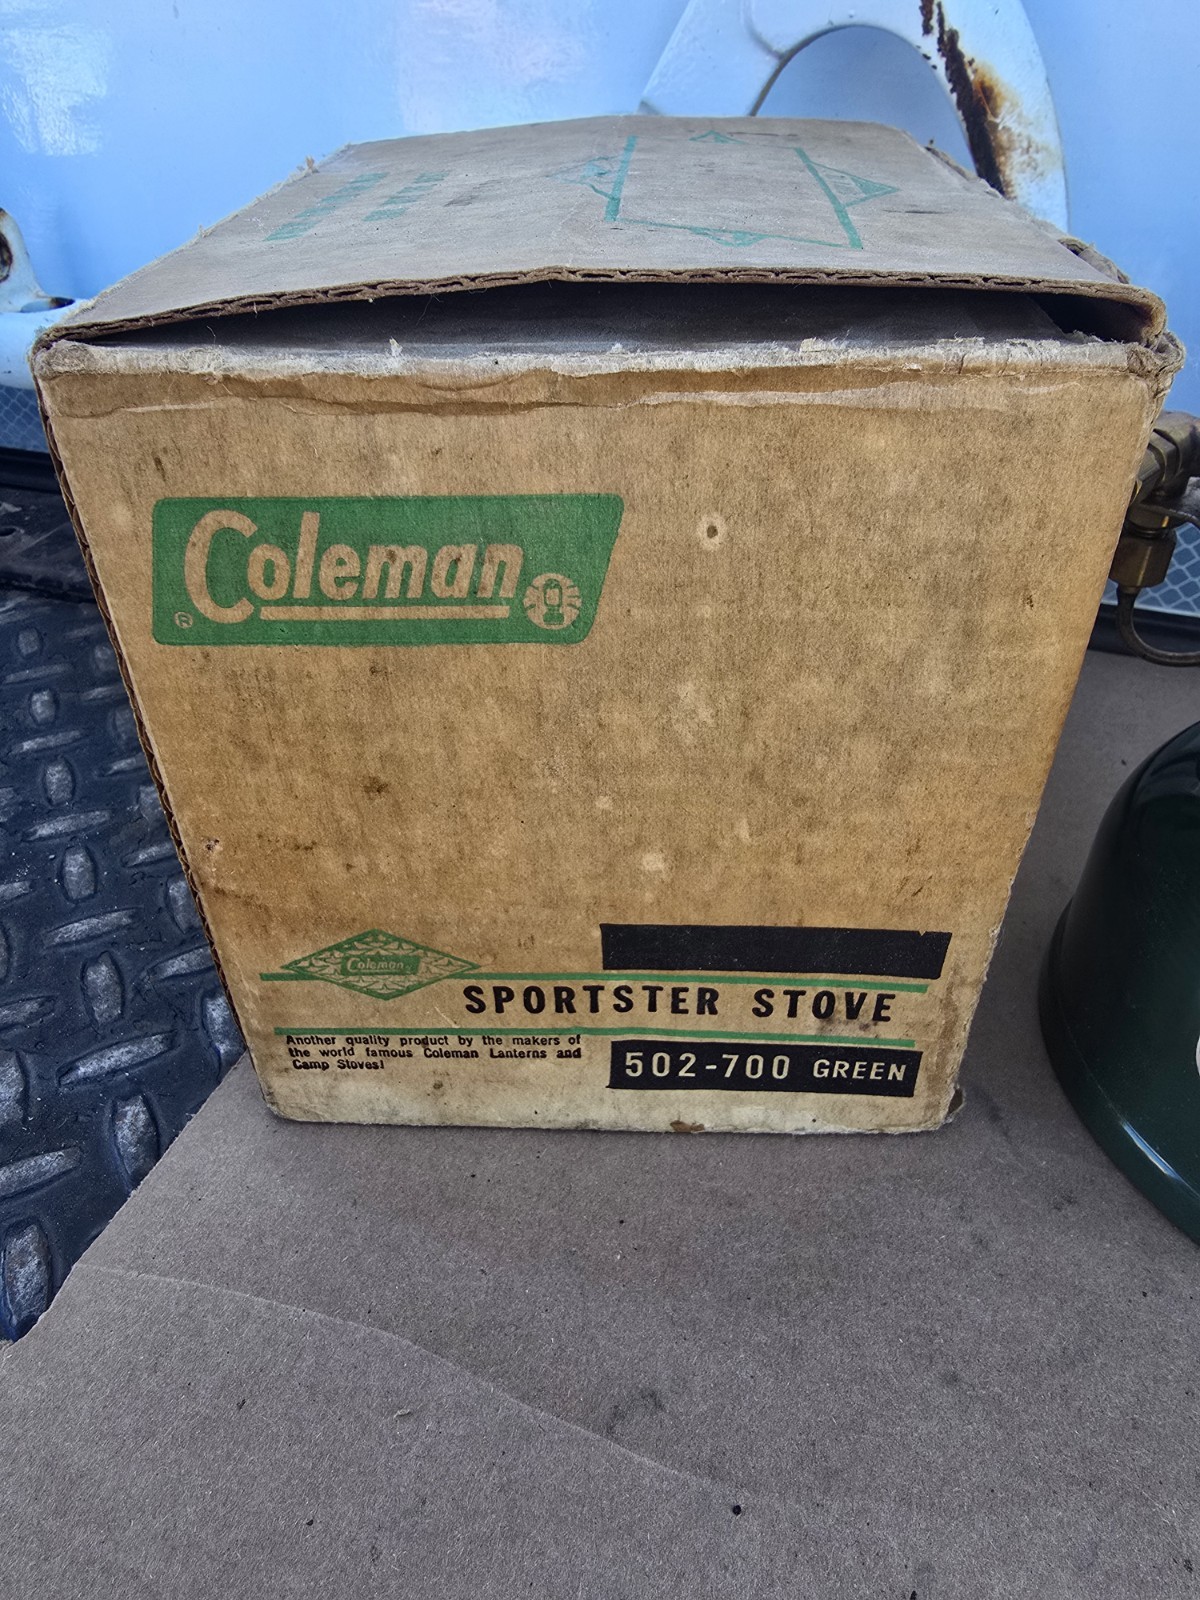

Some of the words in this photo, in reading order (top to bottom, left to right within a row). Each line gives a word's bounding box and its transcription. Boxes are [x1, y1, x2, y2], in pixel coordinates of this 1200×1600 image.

[184, 510, 525, 624] Coleman
[346, 957, 404, 973] Coleman
[463, 984, 719, 1016] SPORTSTER
[752, 989, 895, 1022] STOVE
[286, 1035, 335, 1046] Another
[346, 1035, 389, 1047] quality
[400, 1036, 449, 1047] product
[458, 1035, 473, 1047] by
[482, 1035, 503, 1046] the
[512, 1035, 560, 1046] makers
[568, 1035, 580, 1045] of
[288, 1047, 310, 1059] the
[319, 1047, 354, 1058] world
[366, 1047, 413, 1059] famous
[423, 1048, 479, 1060] Coleman
[490, 1048, 547, 1059] Lanterns
[556, 1048, 581, 1059] and
[292, 1059, 329, 1072] Camp
[337, 1059, 384, 1070] Stoves!
[625, 1052, 790, 1080] 502-700
[812, 1058, 906, 1082] GREEN
